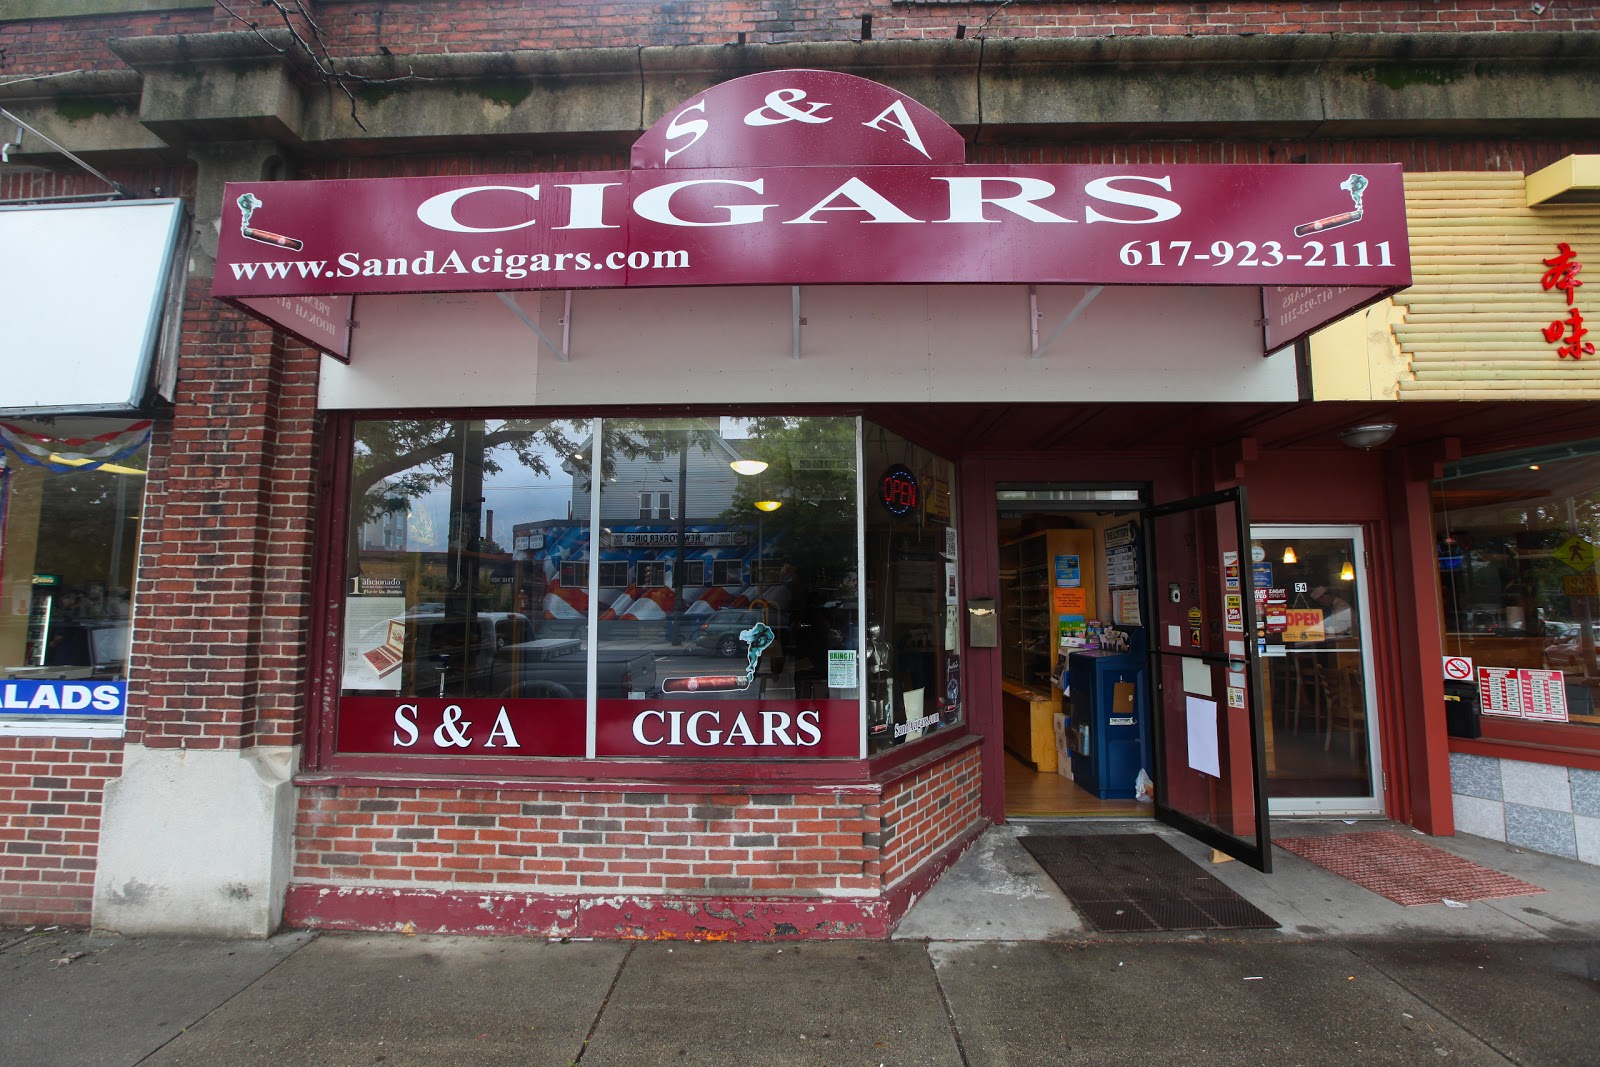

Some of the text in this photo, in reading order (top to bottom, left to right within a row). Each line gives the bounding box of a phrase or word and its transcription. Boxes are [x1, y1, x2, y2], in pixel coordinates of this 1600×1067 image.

[664, 88, 932, 165] S & A
[417, 175, 1182, 232] CIGARS
[230, 248, 691, 281] www.SandAcigars.com
[1119, 240, 1396, 267] 617-923-2111
[883, 477, 917, 507] OPEN
[1295, 583, 1307, 592] 54
[1287, 612, 1320, 627] OPEN
[830, 652, 848, 660] BRING
[0, 684, 119, 711] LADS
[393, 705, 521, 748] S & A
[632, 710, 822, 746] CIGARS
